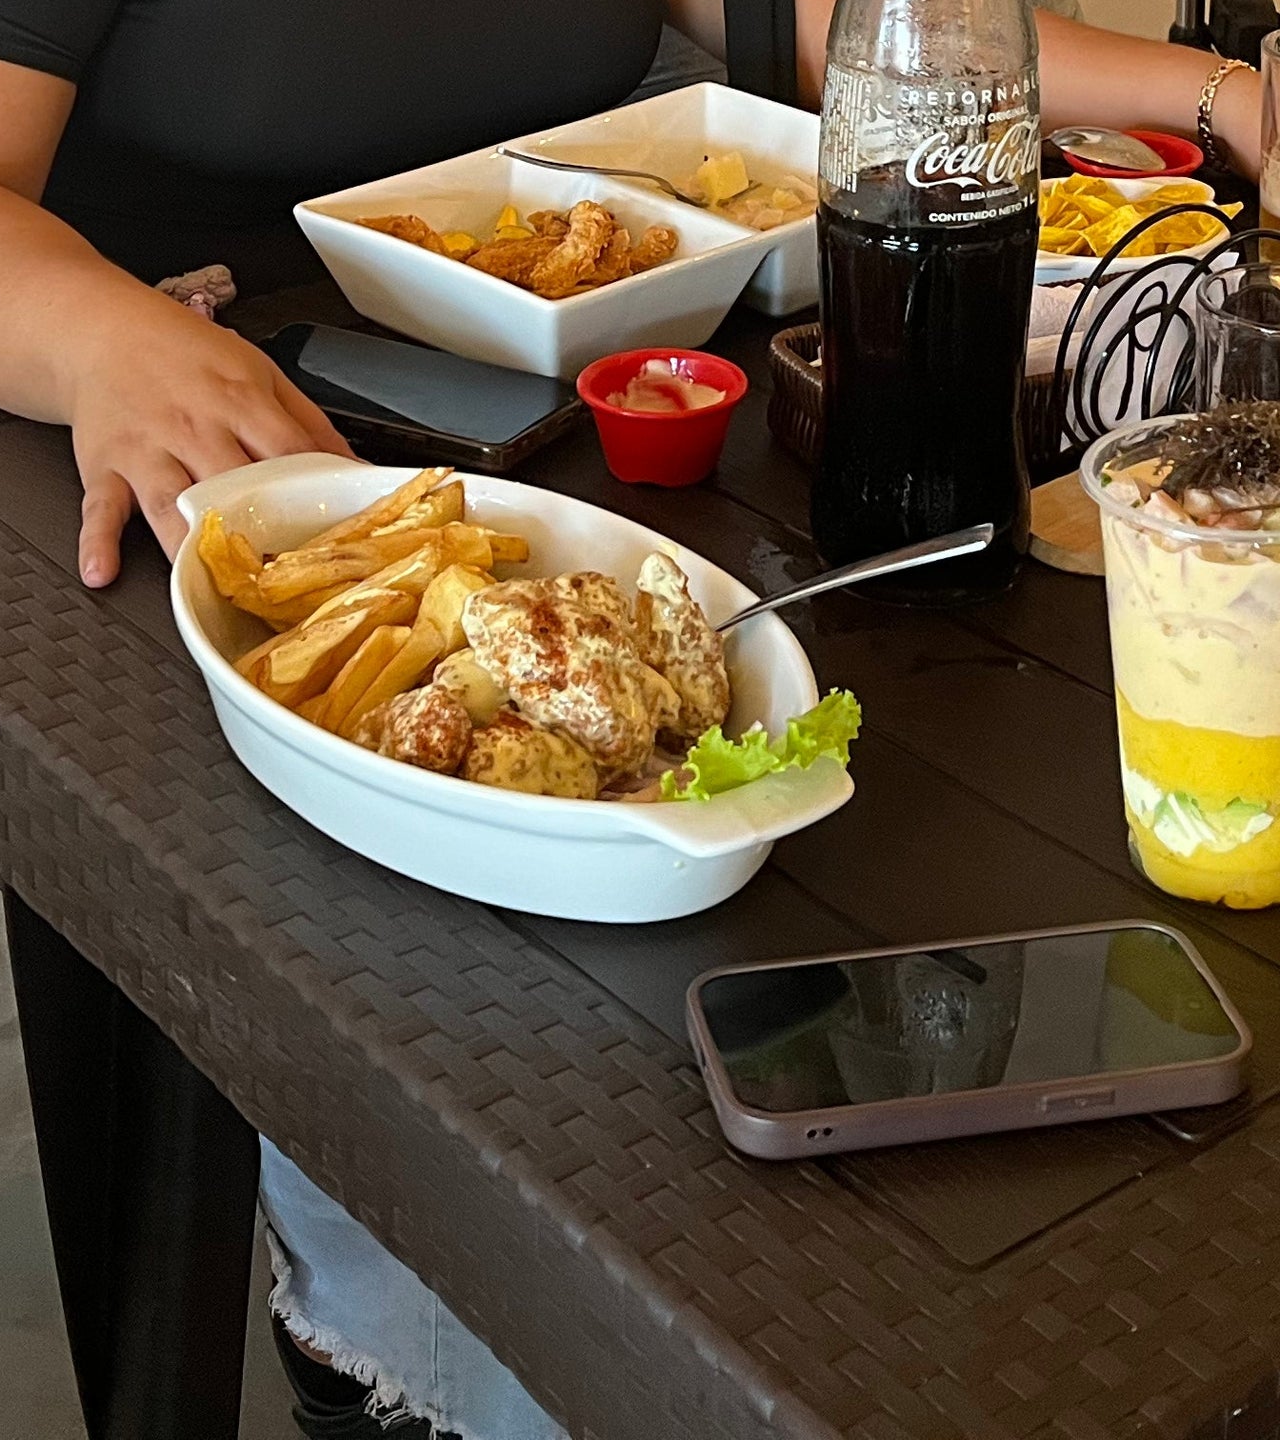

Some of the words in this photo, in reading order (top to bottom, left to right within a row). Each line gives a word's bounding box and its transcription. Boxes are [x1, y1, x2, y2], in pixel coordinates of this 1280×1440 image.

[944, 114, 986, 128] SABOR
[928, 209, 997, 223] CONTENIDO
[998, 202, 1022, 216] NETO
